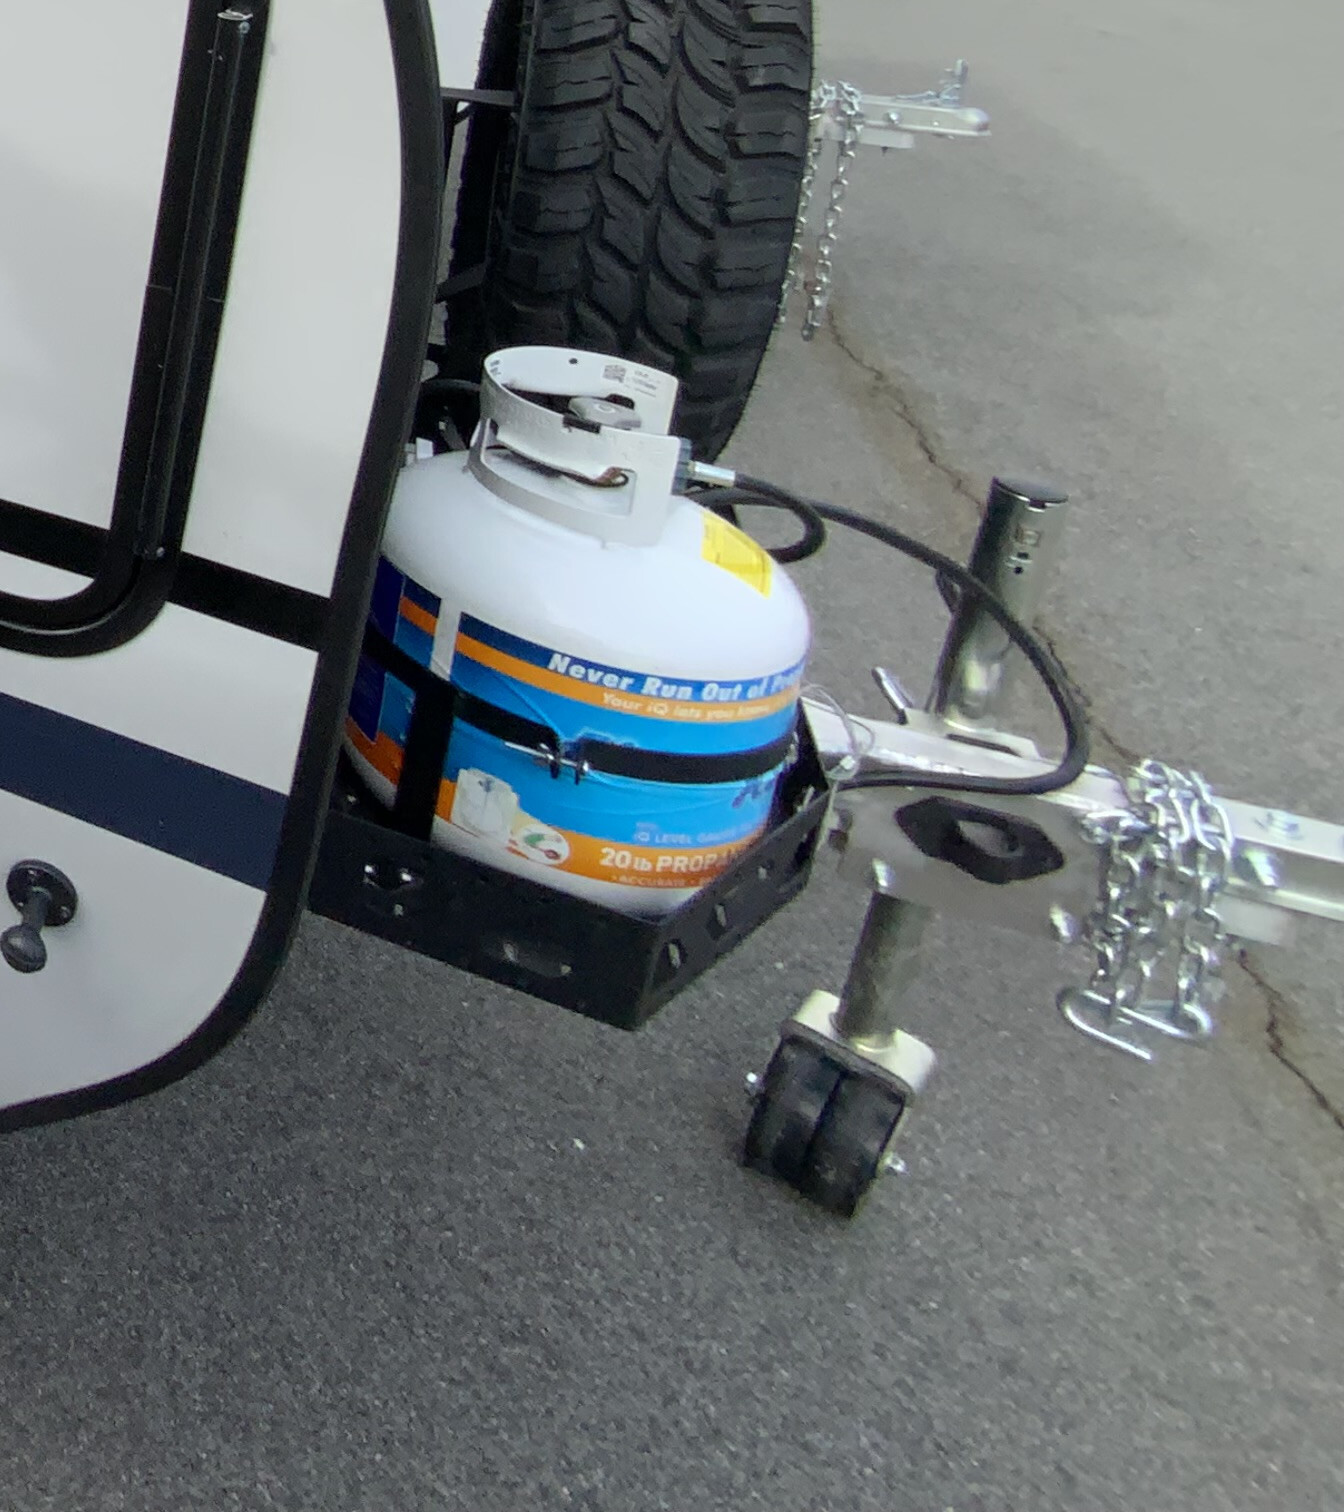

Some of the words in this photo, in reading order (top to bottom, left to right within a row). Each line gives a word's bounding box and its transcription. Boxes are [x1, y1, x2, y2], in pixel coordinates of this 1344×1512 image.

[548, 653, 634, 691] Never
[640, 676, 693, 700] Run
[700, 682, 743, 702] Out
[603, 691, 641, 711] Your
[600, 846, 632, 869] 20
[633, 857, 653, 872] lb
